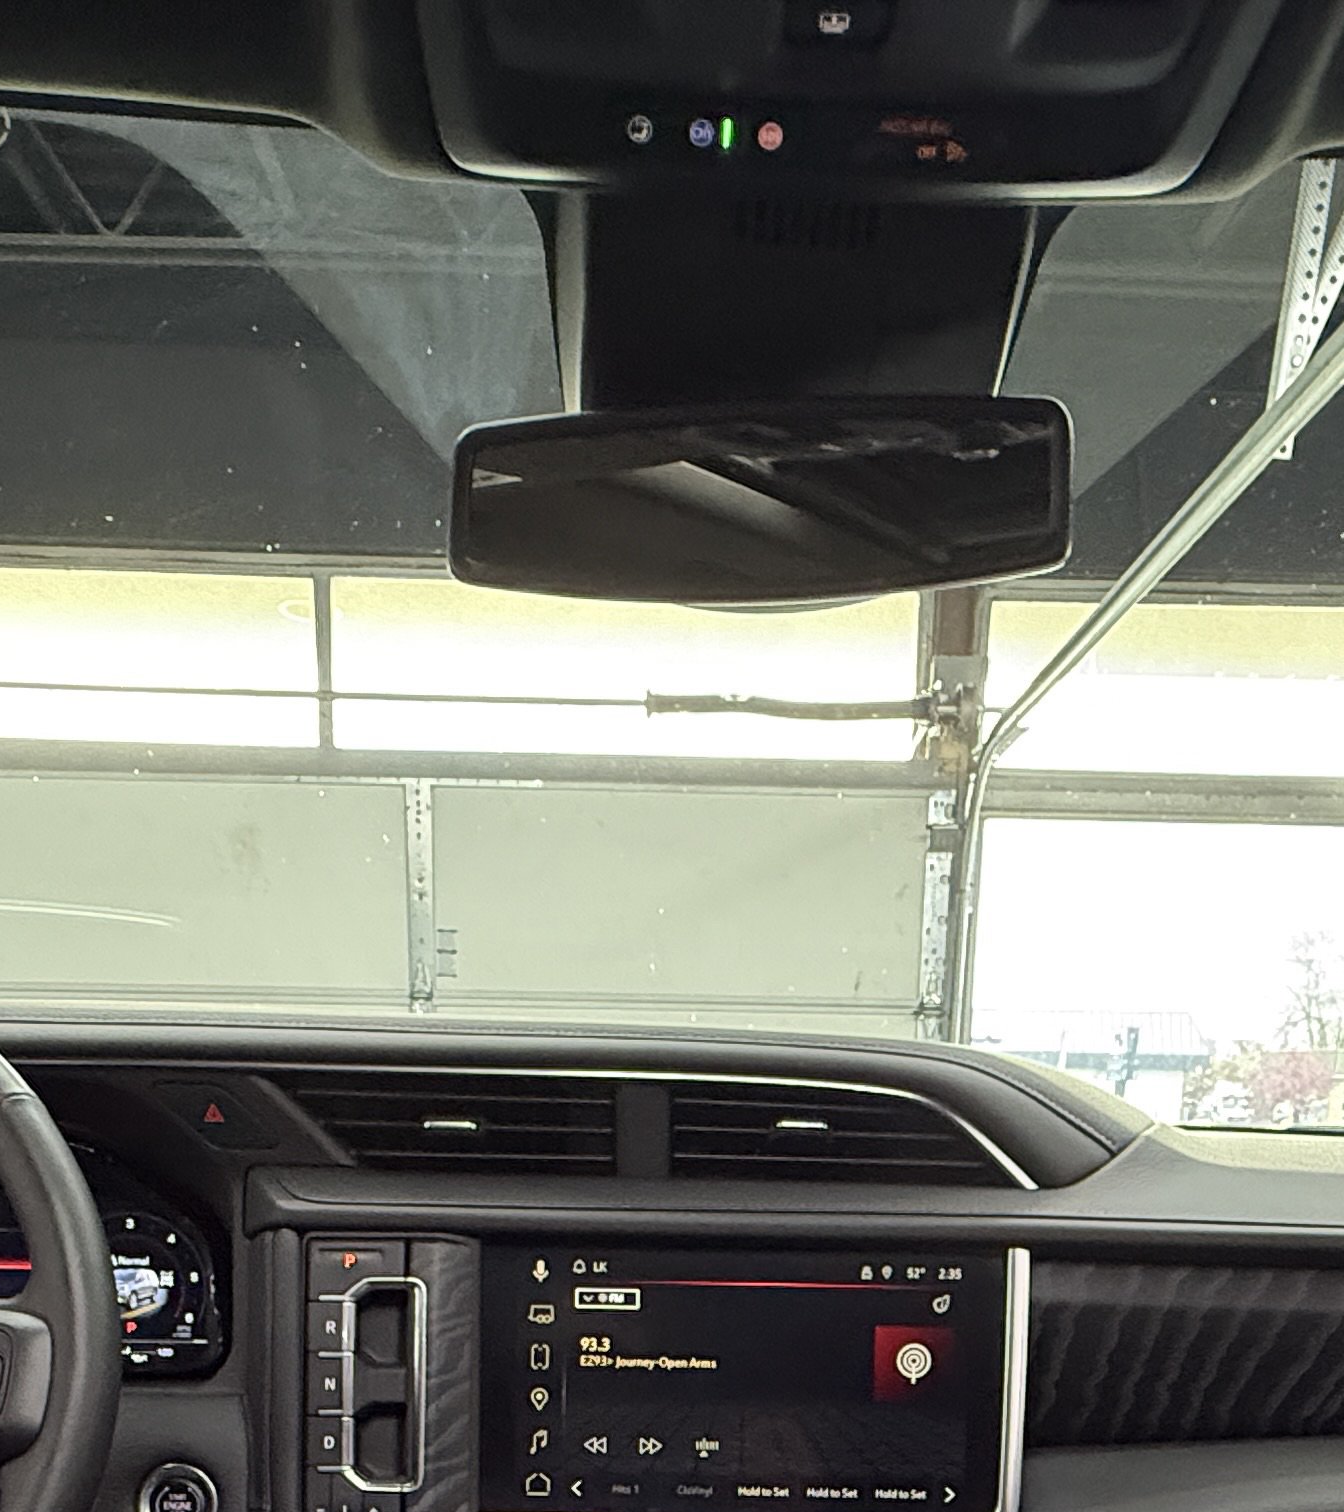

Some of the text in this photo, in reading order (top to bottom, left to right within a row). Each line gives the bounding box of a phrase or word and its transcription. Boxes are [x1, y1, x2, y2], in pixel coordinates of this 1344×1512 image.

[343, 1253, 355, 1269] P
[126, 1321, 137, 1333] P
[325, 1320, 337, 1334] R
[580, 1337, 611, 1352] 93.3
[689, 1357, 717, 1369] Arms
[324, 1377, 336, 1391] N
[323, 1436, 336, 1450] D
[737, 1486, 790, 1498] Hold to Set
[806, 1487, 858, 1499] Hold to Set
[875, 1489, 927, 1500] Hold to Set
